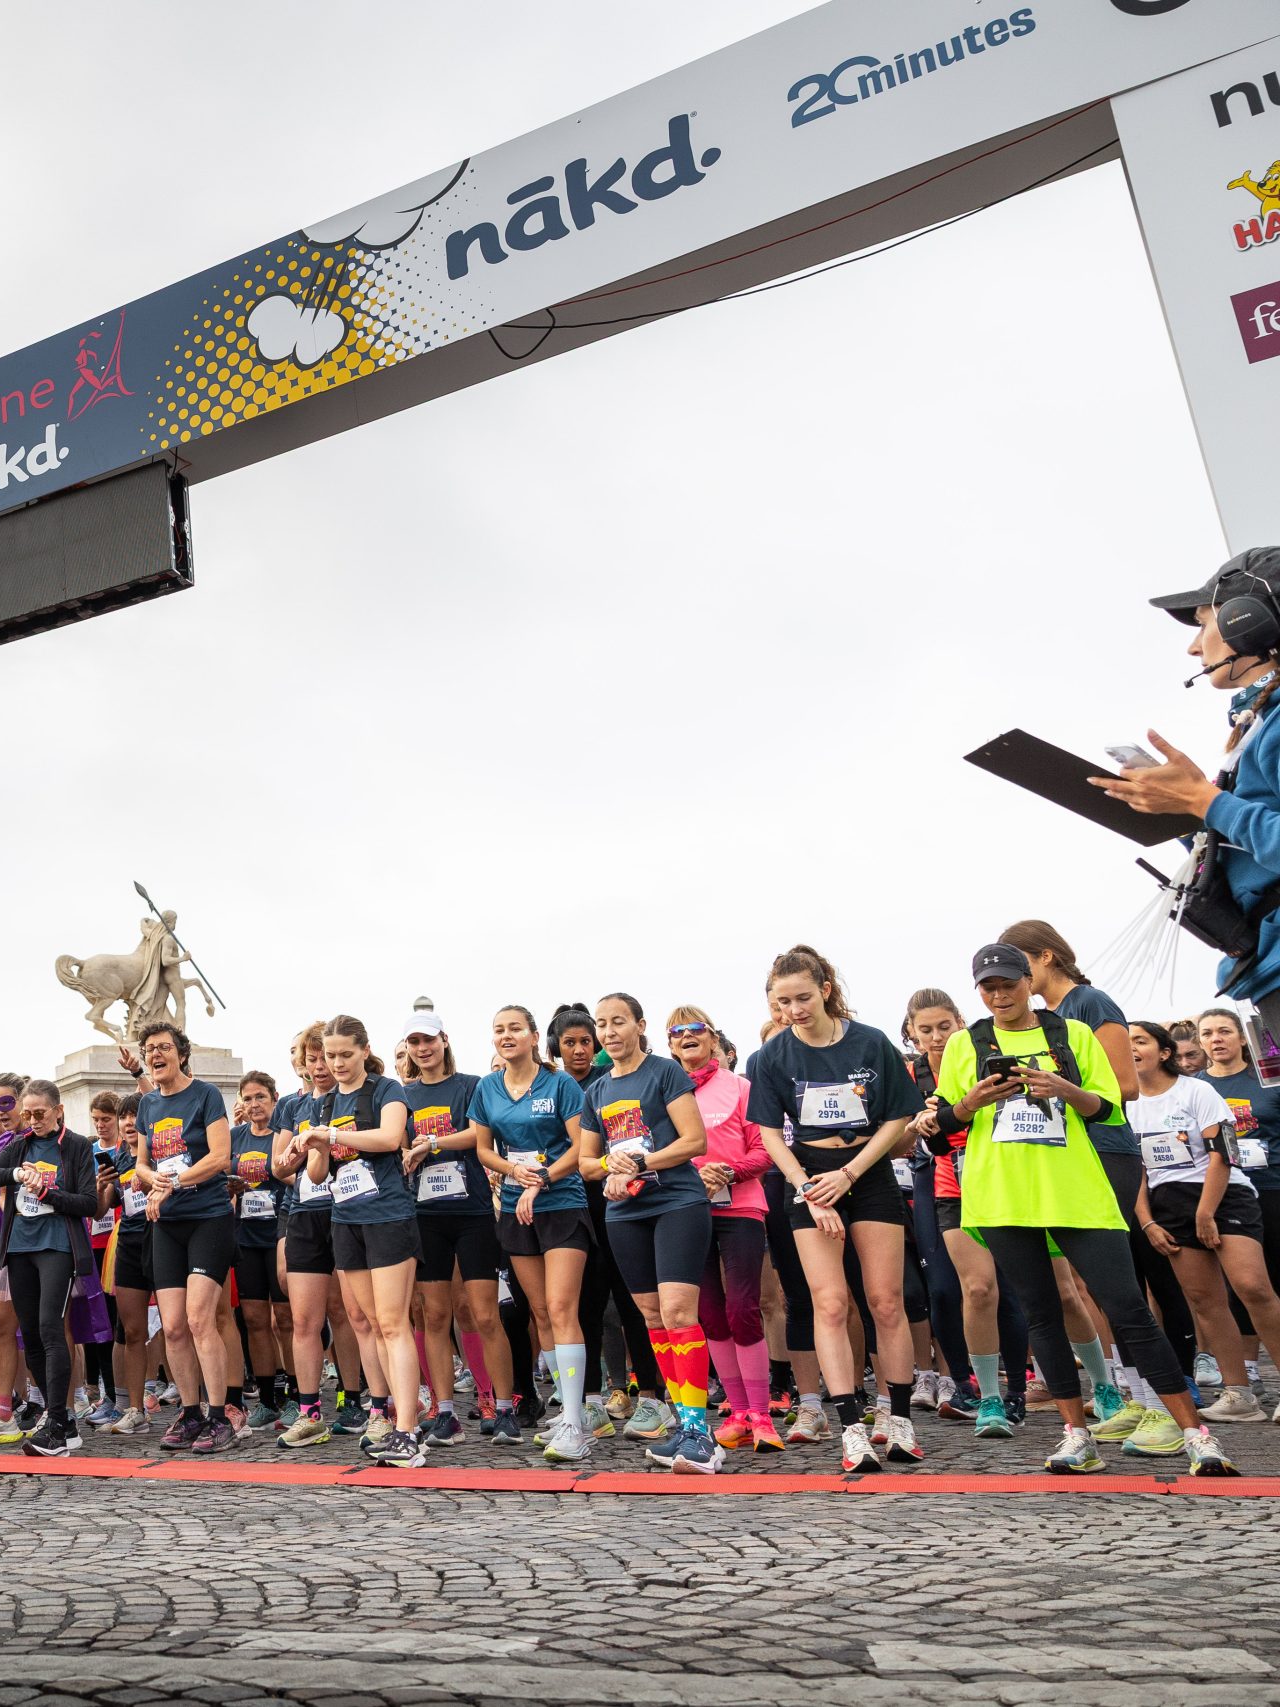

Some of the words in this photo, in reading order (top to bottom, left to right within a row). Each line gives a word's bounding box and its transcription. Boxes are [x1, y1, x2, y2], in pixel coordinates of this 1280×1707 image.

[824, 1098, 838, 1109] LÉA
[818, 1110, 846, 1119] 29794
[1012, 1110, 1048, 1123] LAËTITIA
[1013, 1123, 1045, 1134] 25282
[427, 1175, 452, 1183] CAMILLE
[432, 1184, 447, 1192] 6951
